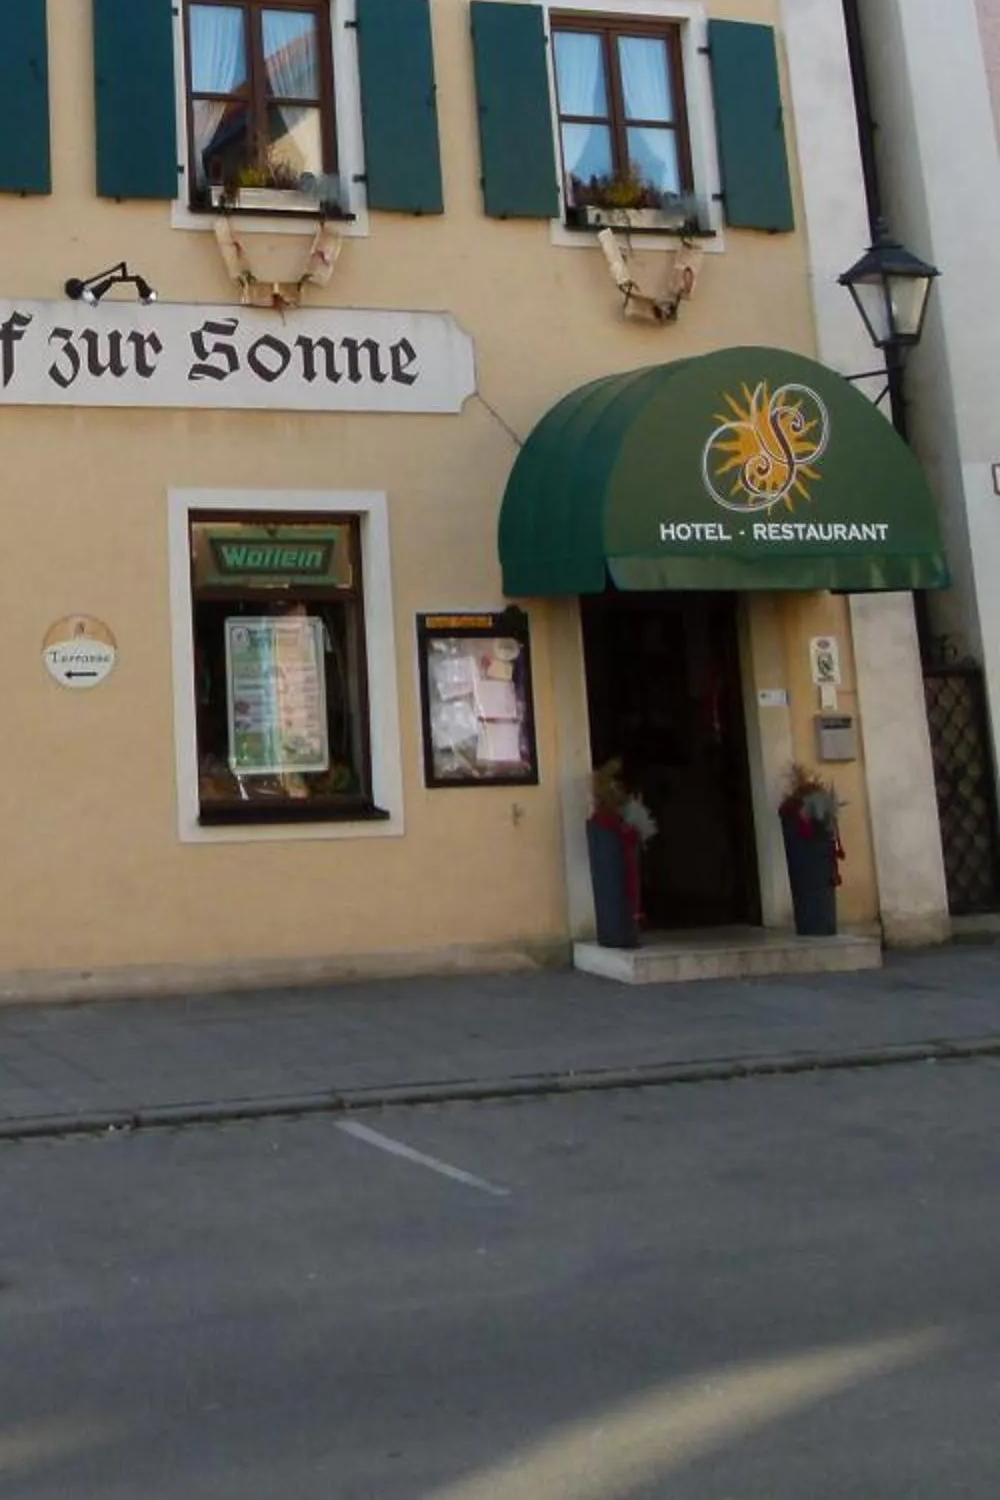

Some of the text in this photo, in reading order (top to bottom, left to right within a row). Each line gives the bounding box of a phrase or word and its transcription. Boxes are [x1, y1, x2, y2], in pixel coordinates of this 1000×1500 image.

[48, 326, 163, 389] zur
[187, 317, 420, 386] Sonne
[660, 523, 732, 541] HOTEL
[752, 523, 888, 541] RESTAURANT
